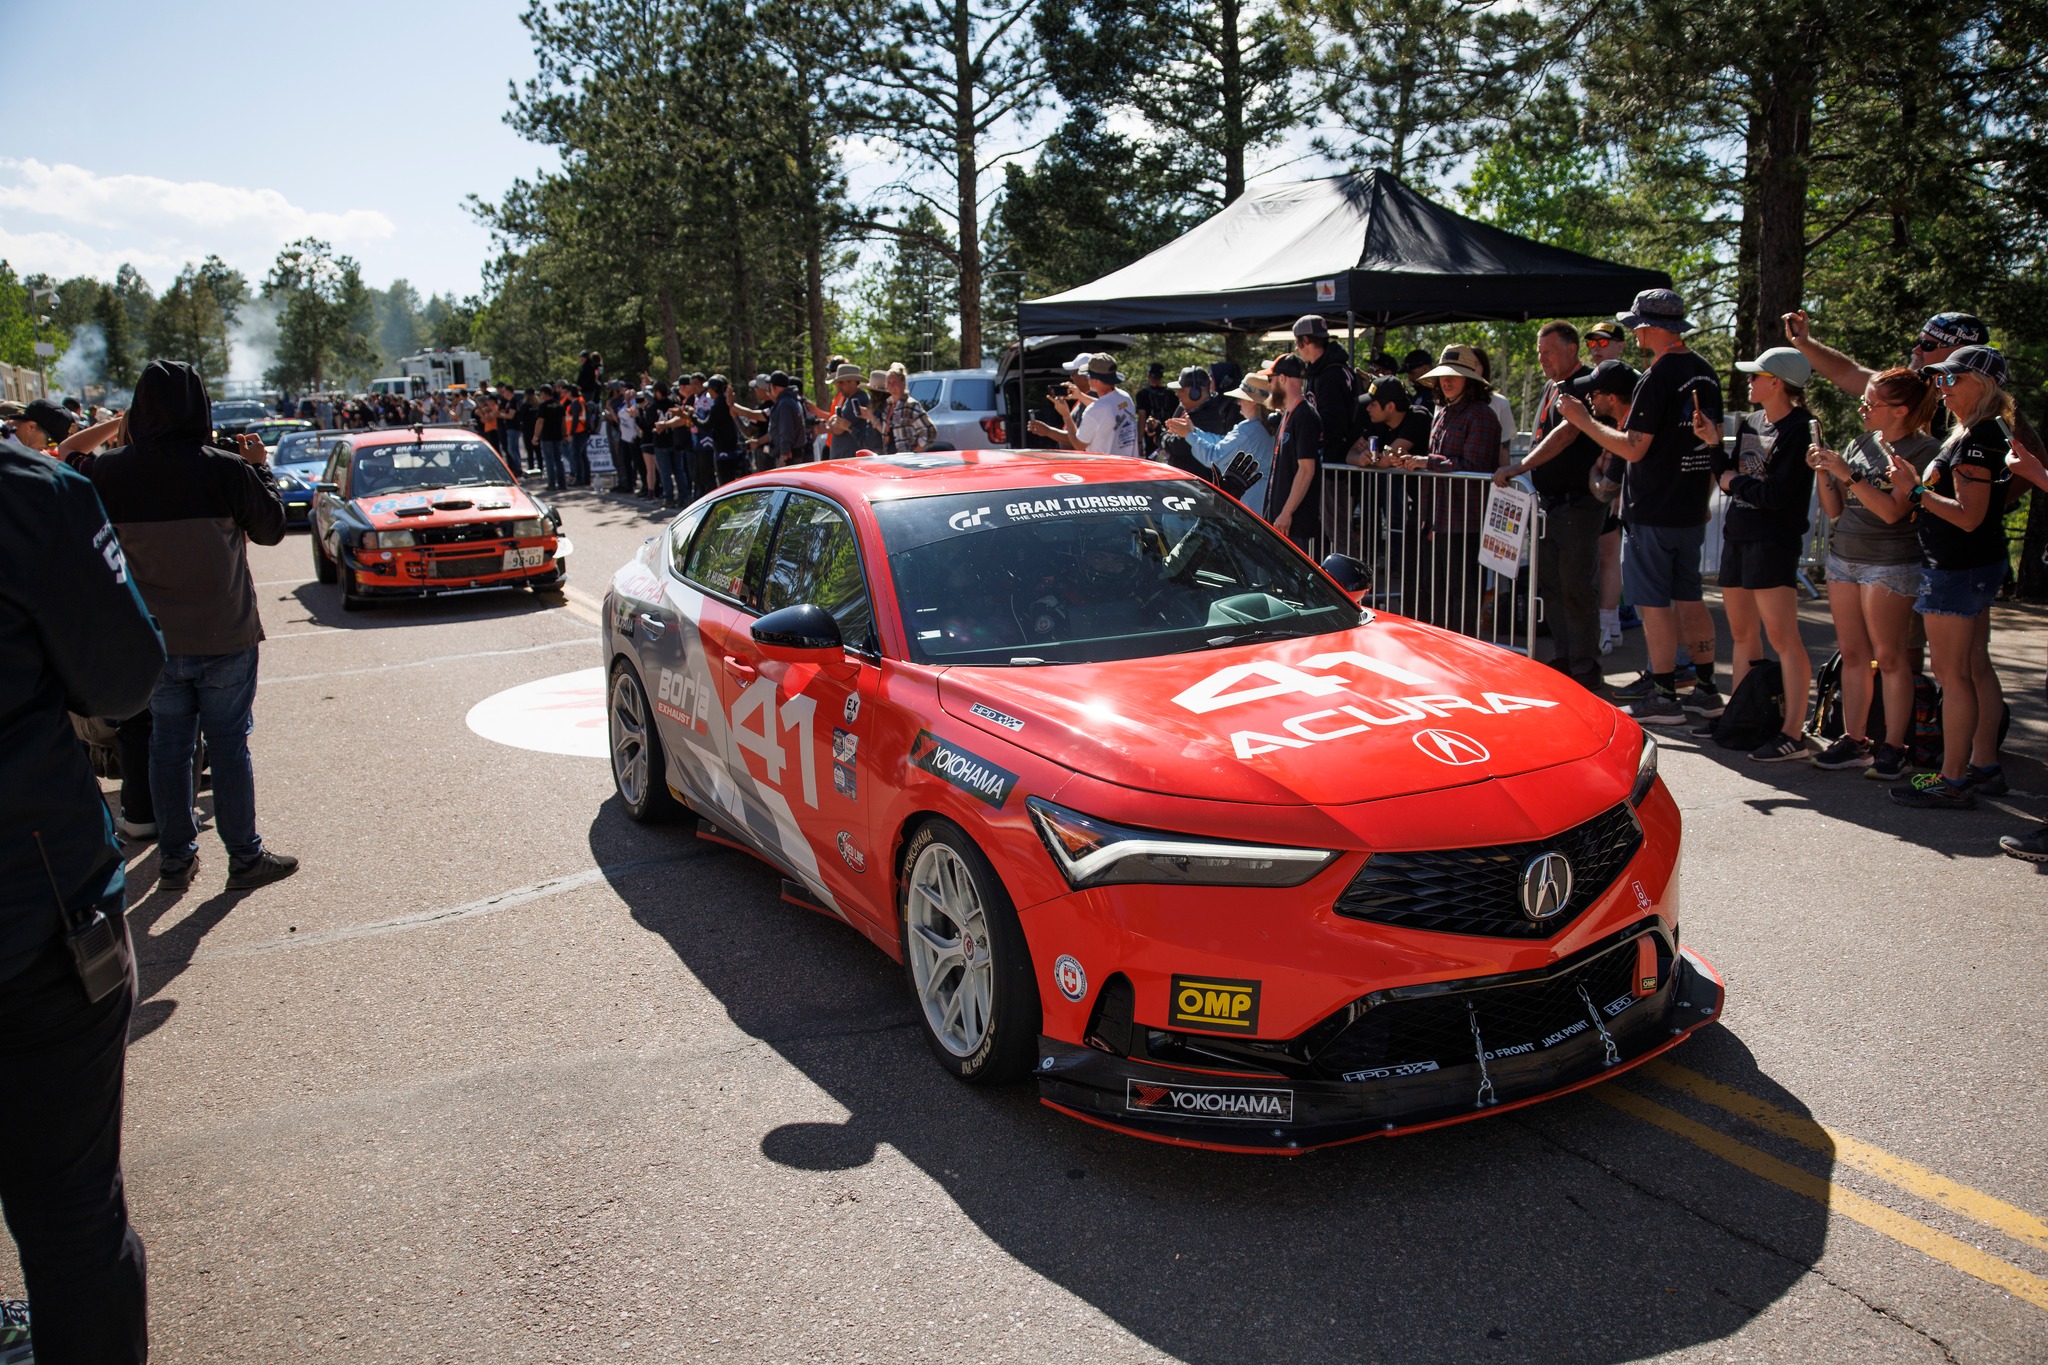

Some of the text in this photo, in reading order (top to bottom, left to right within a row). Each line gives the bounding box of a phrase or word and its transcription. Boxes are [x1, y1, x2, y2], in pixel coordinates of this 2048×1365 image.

[1005, 498, 1062, 516] GRAN
[1026, 512, 1058, 521] REAL
[1058, 507, 1098, 517] DRIVING
[1099, 505, 1152, 515] SIMULATOR
[1171, 651, 1438, 714] 41
[658, 702, 691, 725] EXHAUST
[846, 698, 858, 715] EX
[971, 703, 997, 720] HPD
[1229, 691, 1561, 759] ACURA
[731, 676, 819, 811] 41
[932, 745, 1005, 800] YOKOHAMA
[905, 828, 934, 873] YOKOHAMA
[1634, 884, 1649, 907] TOW
[1643, 980, 1656, 988] OMP
[1178, 989, 1252, 1019] OMP
[1606, 997, 1632, 1015] HPD
[1495, 1042, 1535, 1060] FRONT
[1541, 1031, 1566, 1049] JACK
[1562, 1019, 1590, 1038] POINT
[1346, 1070, 1390, 1082] HPD
[1170, 1090, 1283, 1115] YOKOHAMA
